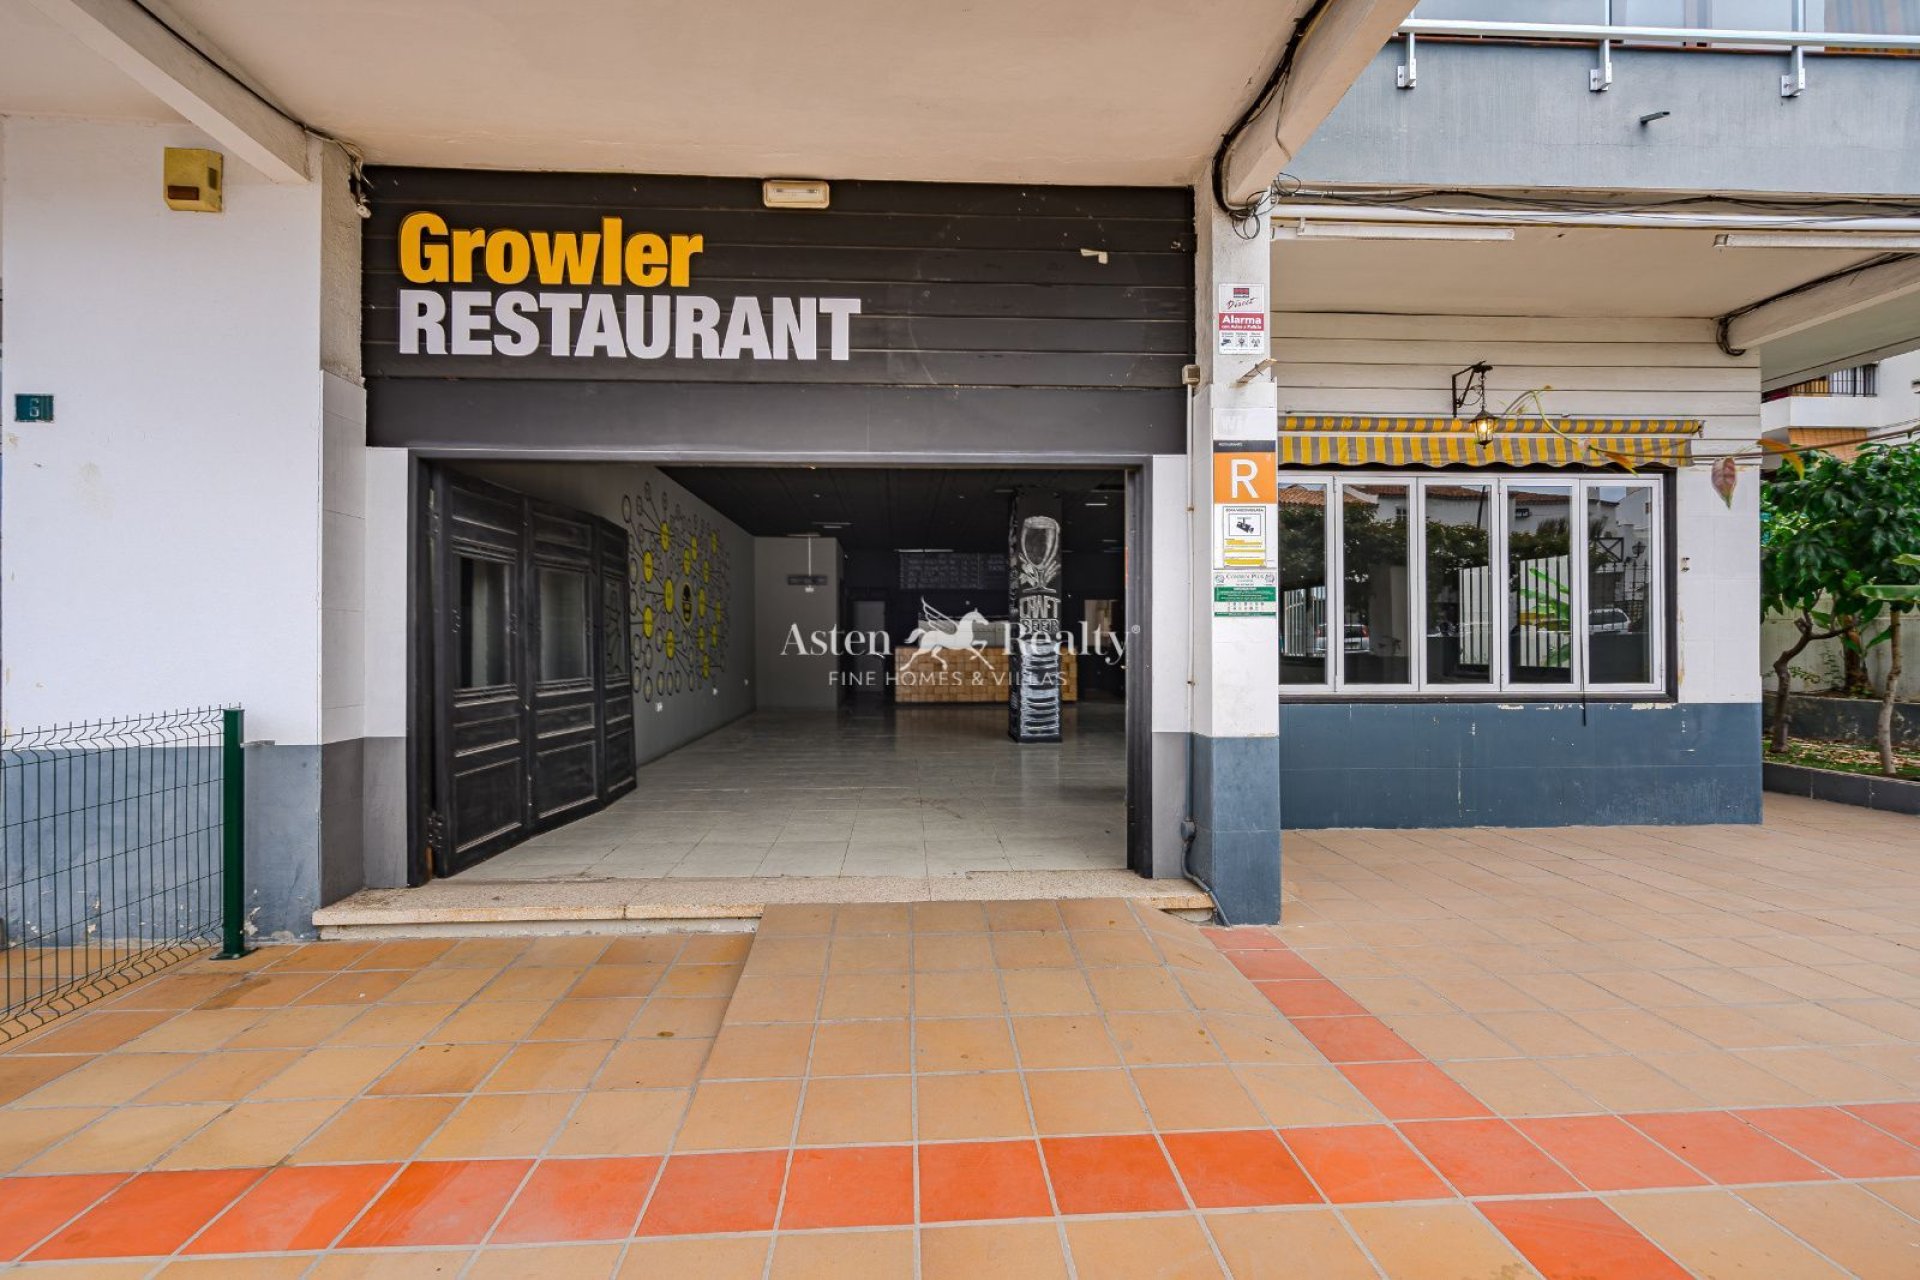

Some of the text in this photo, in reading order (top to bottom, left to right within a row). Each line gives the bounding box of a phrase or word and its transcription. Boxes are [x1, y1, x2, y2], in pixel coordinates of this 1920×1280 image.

[400, 211, 704, 287] Growler
[399, 289, 861, 360] RESTAURANT
[1222, 314, 1262, 324] Alarma
[1231, 458, 1259, 499] R
